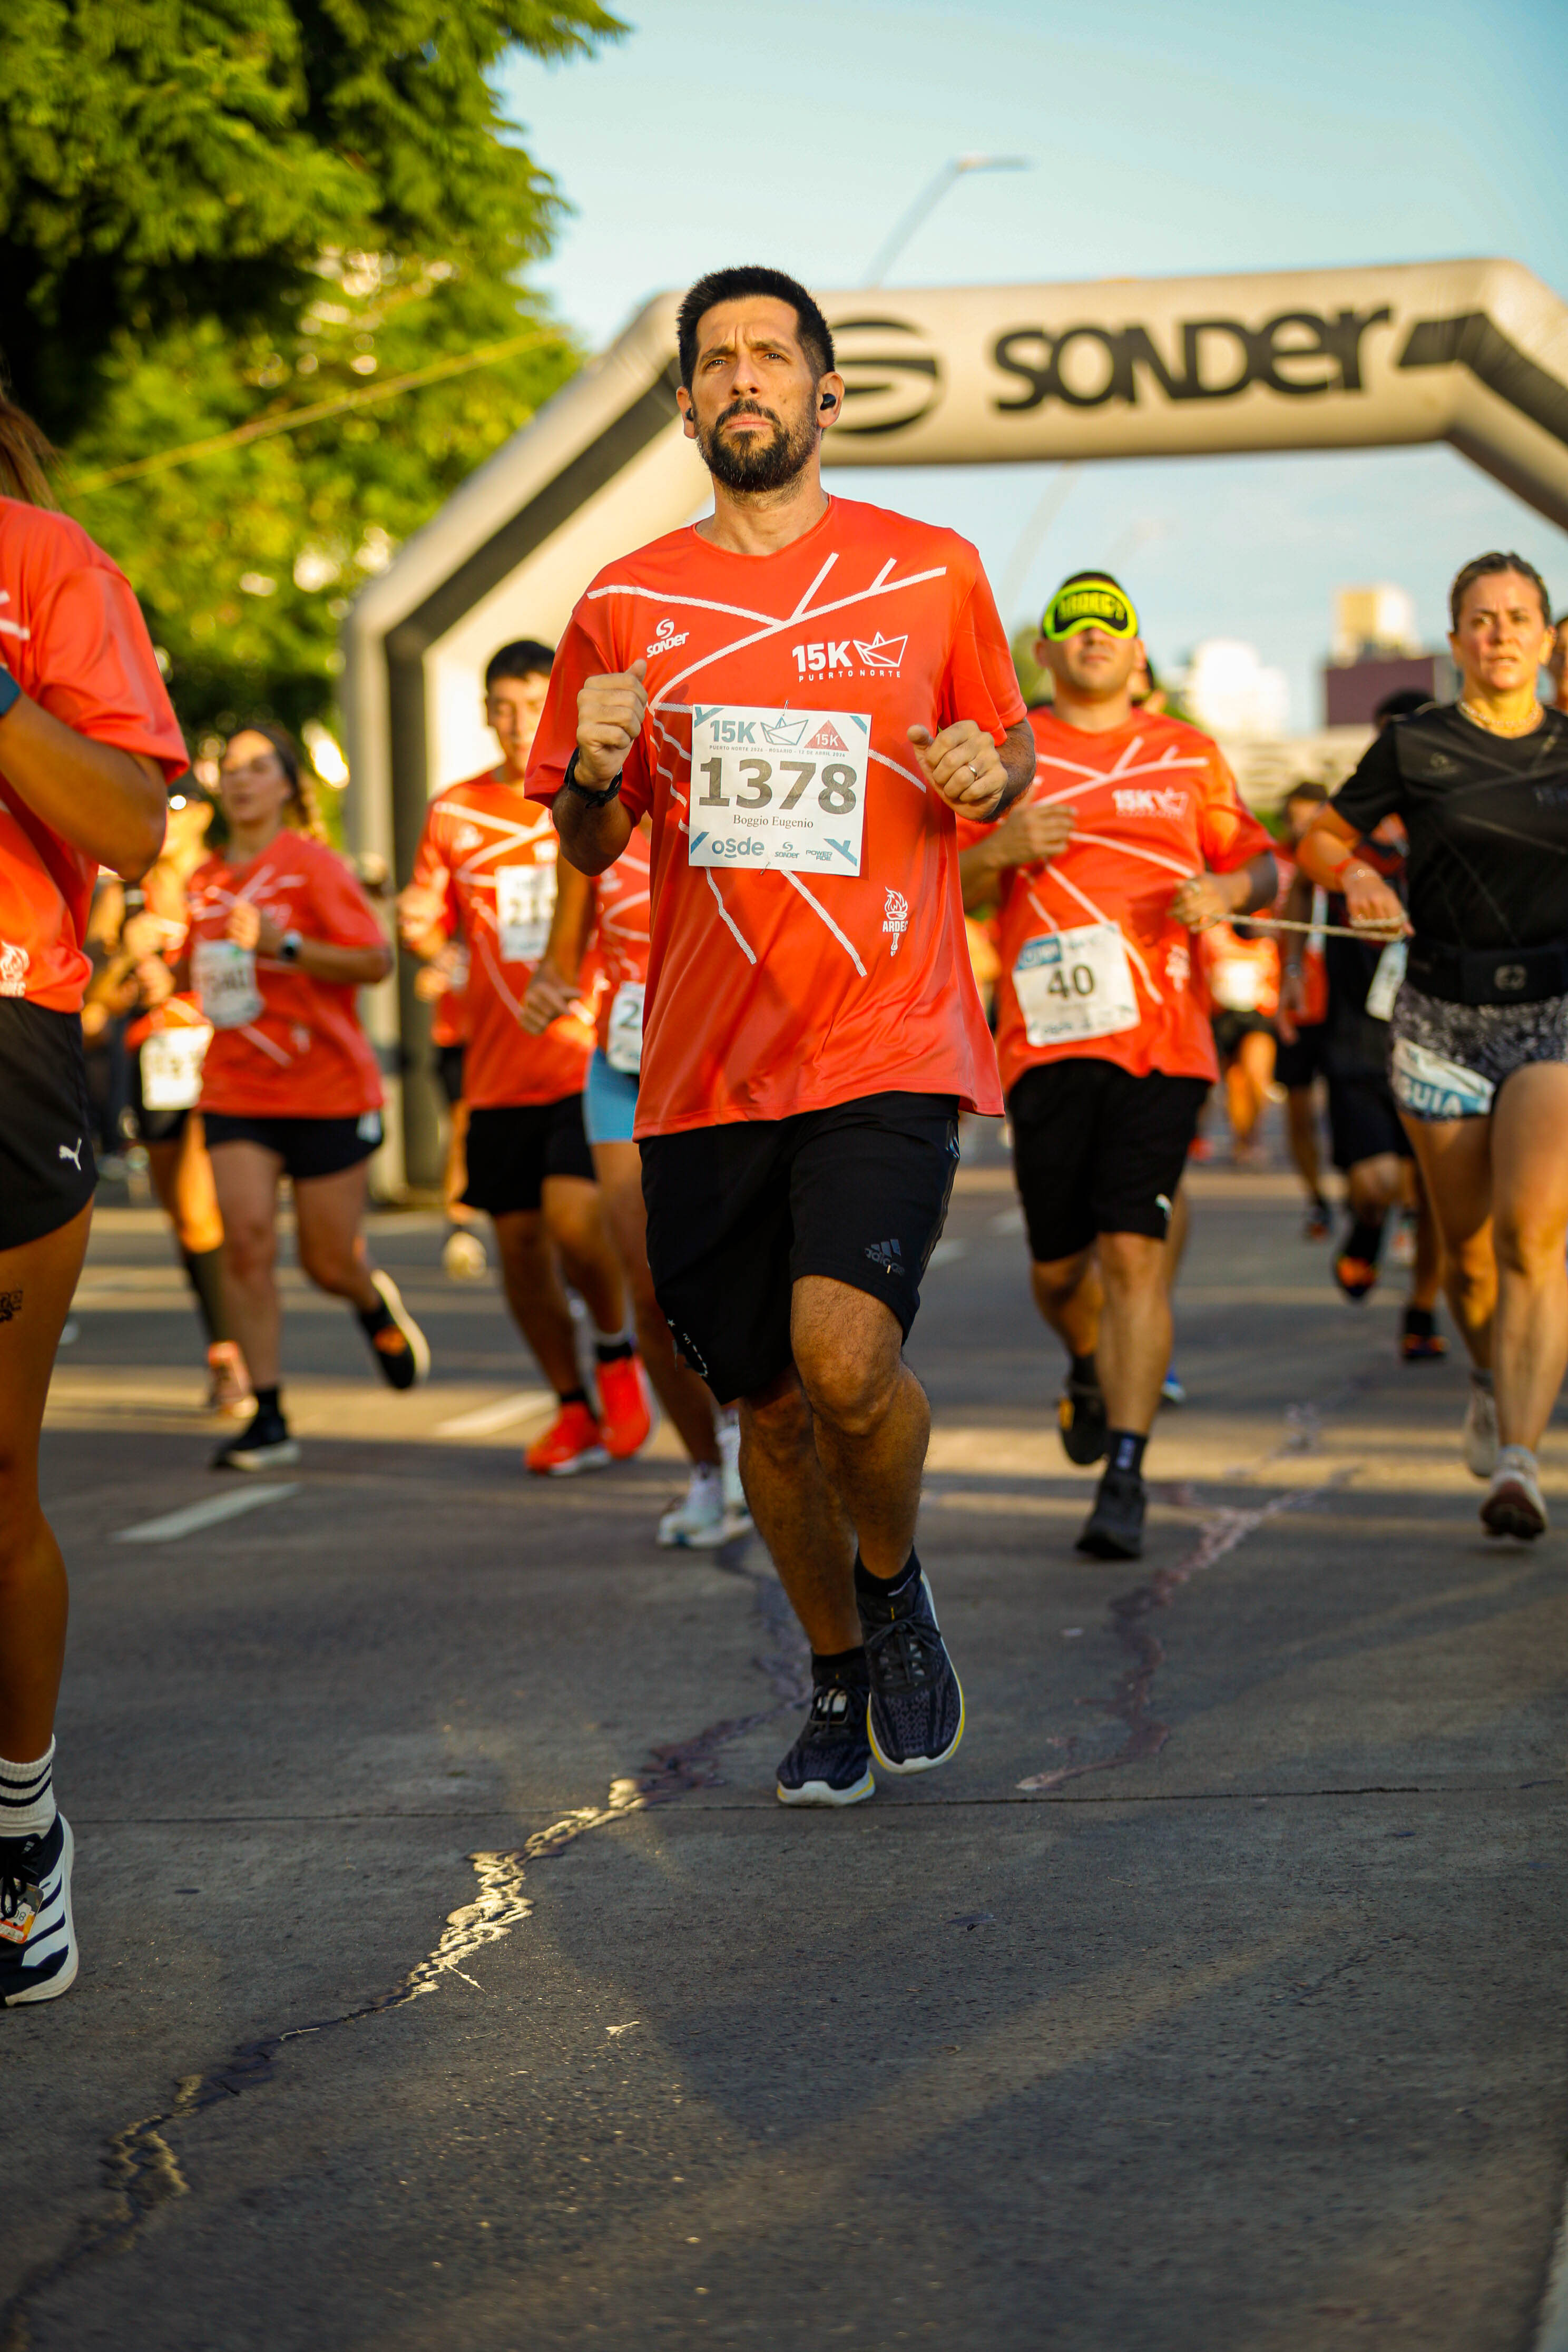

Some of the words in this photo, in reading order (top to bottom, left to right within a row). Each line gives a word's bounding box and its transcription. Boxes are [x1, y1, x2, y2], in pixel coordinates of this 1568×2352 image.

[792, 641, 852, 672] 15K
[799, 670, 853, 682] PUERTO
[860, 669, 900, 678] NORTE
[710, 720, 756, 744] 15K
[816, 733, 839, 747] 15K
[699, 757, 857, 815] 1378
[733, 814, 769, 827] Boggio
[772, 816, 814, 829] Eugenio
[712, 837, 765, 857] osde
[1048, 964, 1094, 1000] 40
